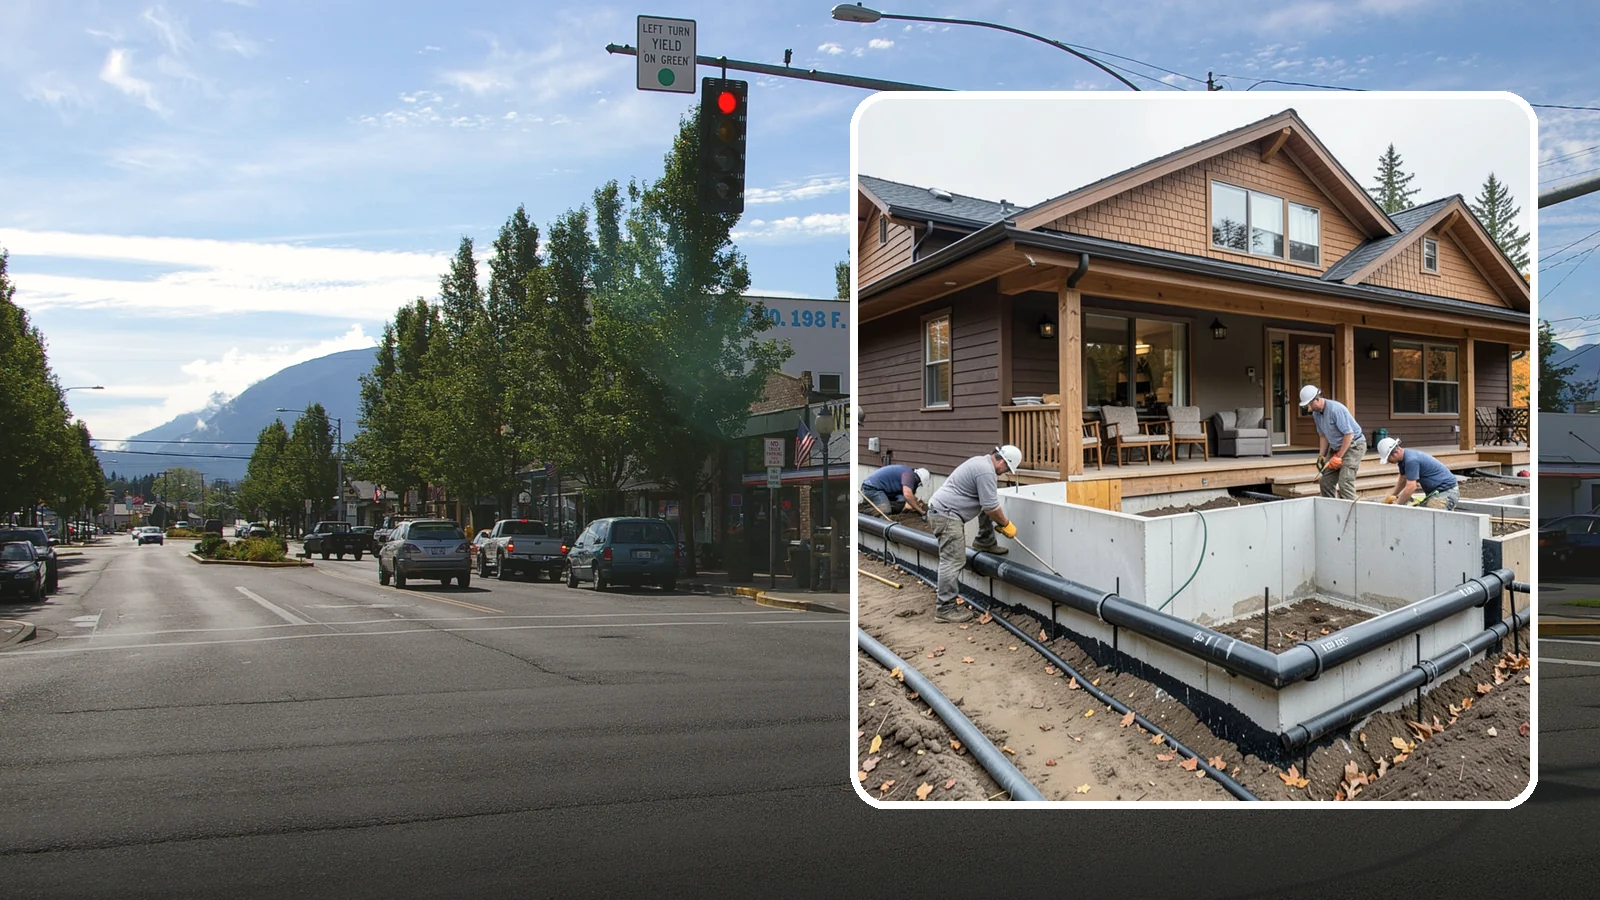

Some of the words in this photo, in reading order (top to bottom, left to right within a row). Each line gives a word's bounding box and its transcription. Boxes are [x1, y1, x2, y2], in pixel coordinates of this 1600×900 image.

[643, 24, 663, 34] LEFT
[668, 26, 690, 36] TURN
[652, 38, 682, 51] YIELD
[644, 53, 656, 63] ON
[661, 55, 689, 66] GREEN
[791, 309, 826, 327] 198
[831, 311, 846, 328] F.
